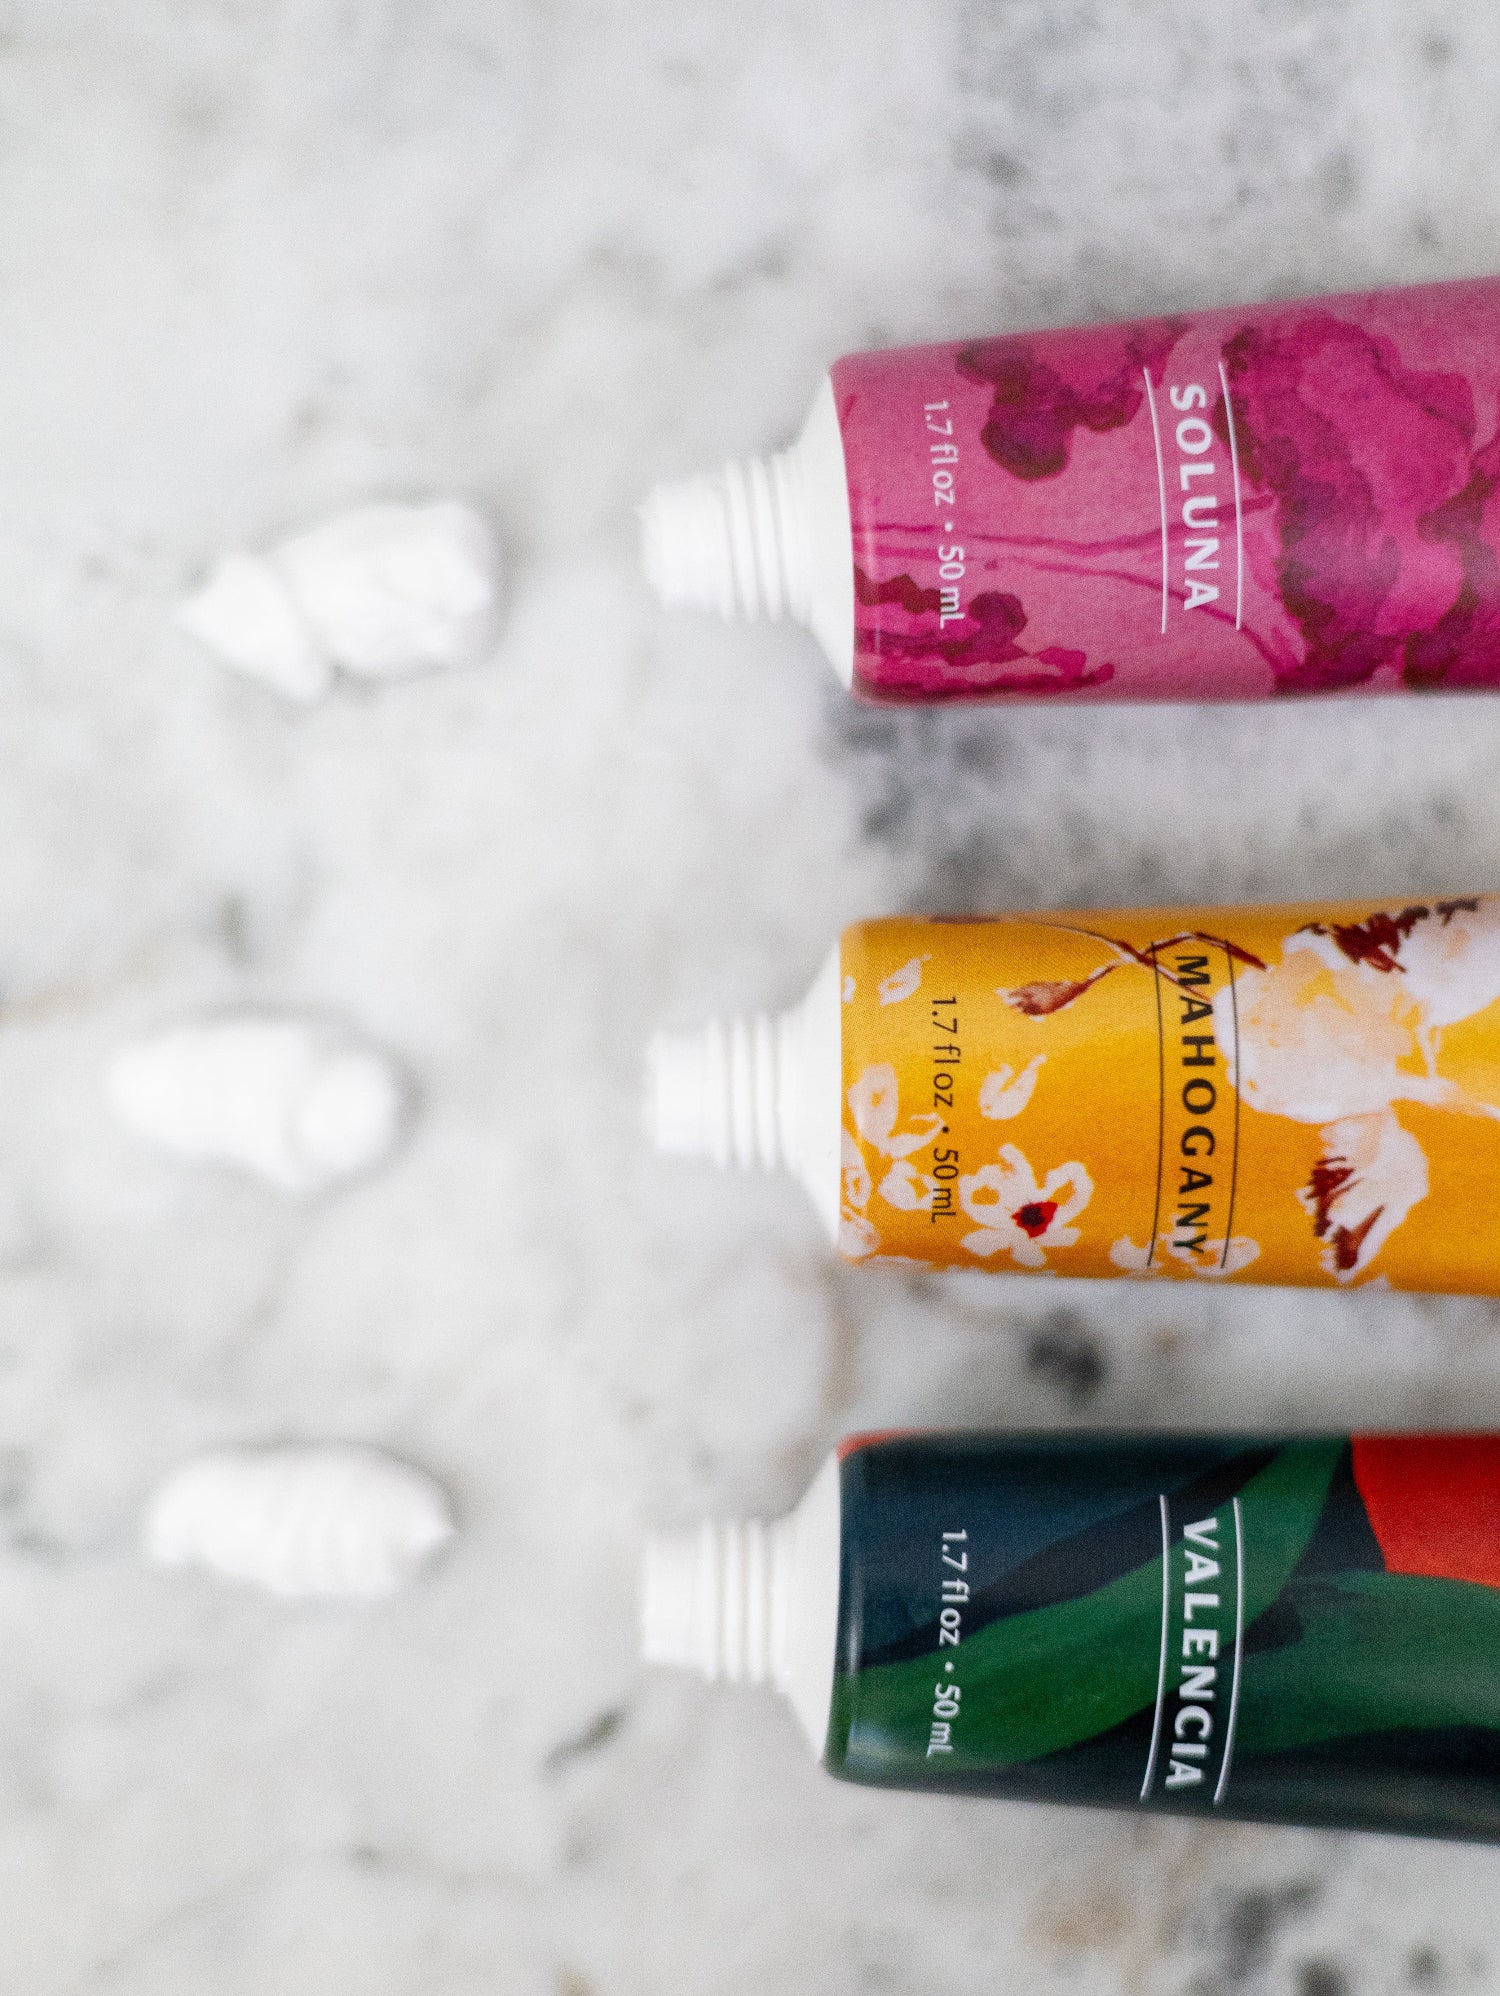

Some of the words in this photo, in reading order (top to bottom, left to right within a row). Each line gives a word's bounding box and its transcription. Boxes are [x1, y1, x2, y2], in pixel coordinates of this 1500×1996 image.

[923, 400, 953, 436] 1.7
[930, 443, 958, 464] fl
[933, 471, 955, 506] oz
[1169, 384, 1220, 611] SOLUNA
[938, 545, 965, 580] 50
[939, 589, 966, 630] mL
[930, 996, 957, 1034] 1.7
[933, 1043, 961, 1065] fl
[933, 1072, 954, 1108] oz
[1173, 955, 1217, 1254] MAHOGANY
[932, 1149, 959, 1181] 50
[931, 1187, 957, 1223] mL
[941, 1529, 968, 1572] 1.7
[940, 1578, 970, 1604] fl
[939, 1608, 961, 1647] oz
[1165, 1517, 1221, 1790] VALENCIA
[933, 1682, 962, 1718] 50
[926, 1722, 954, 1758] mL
